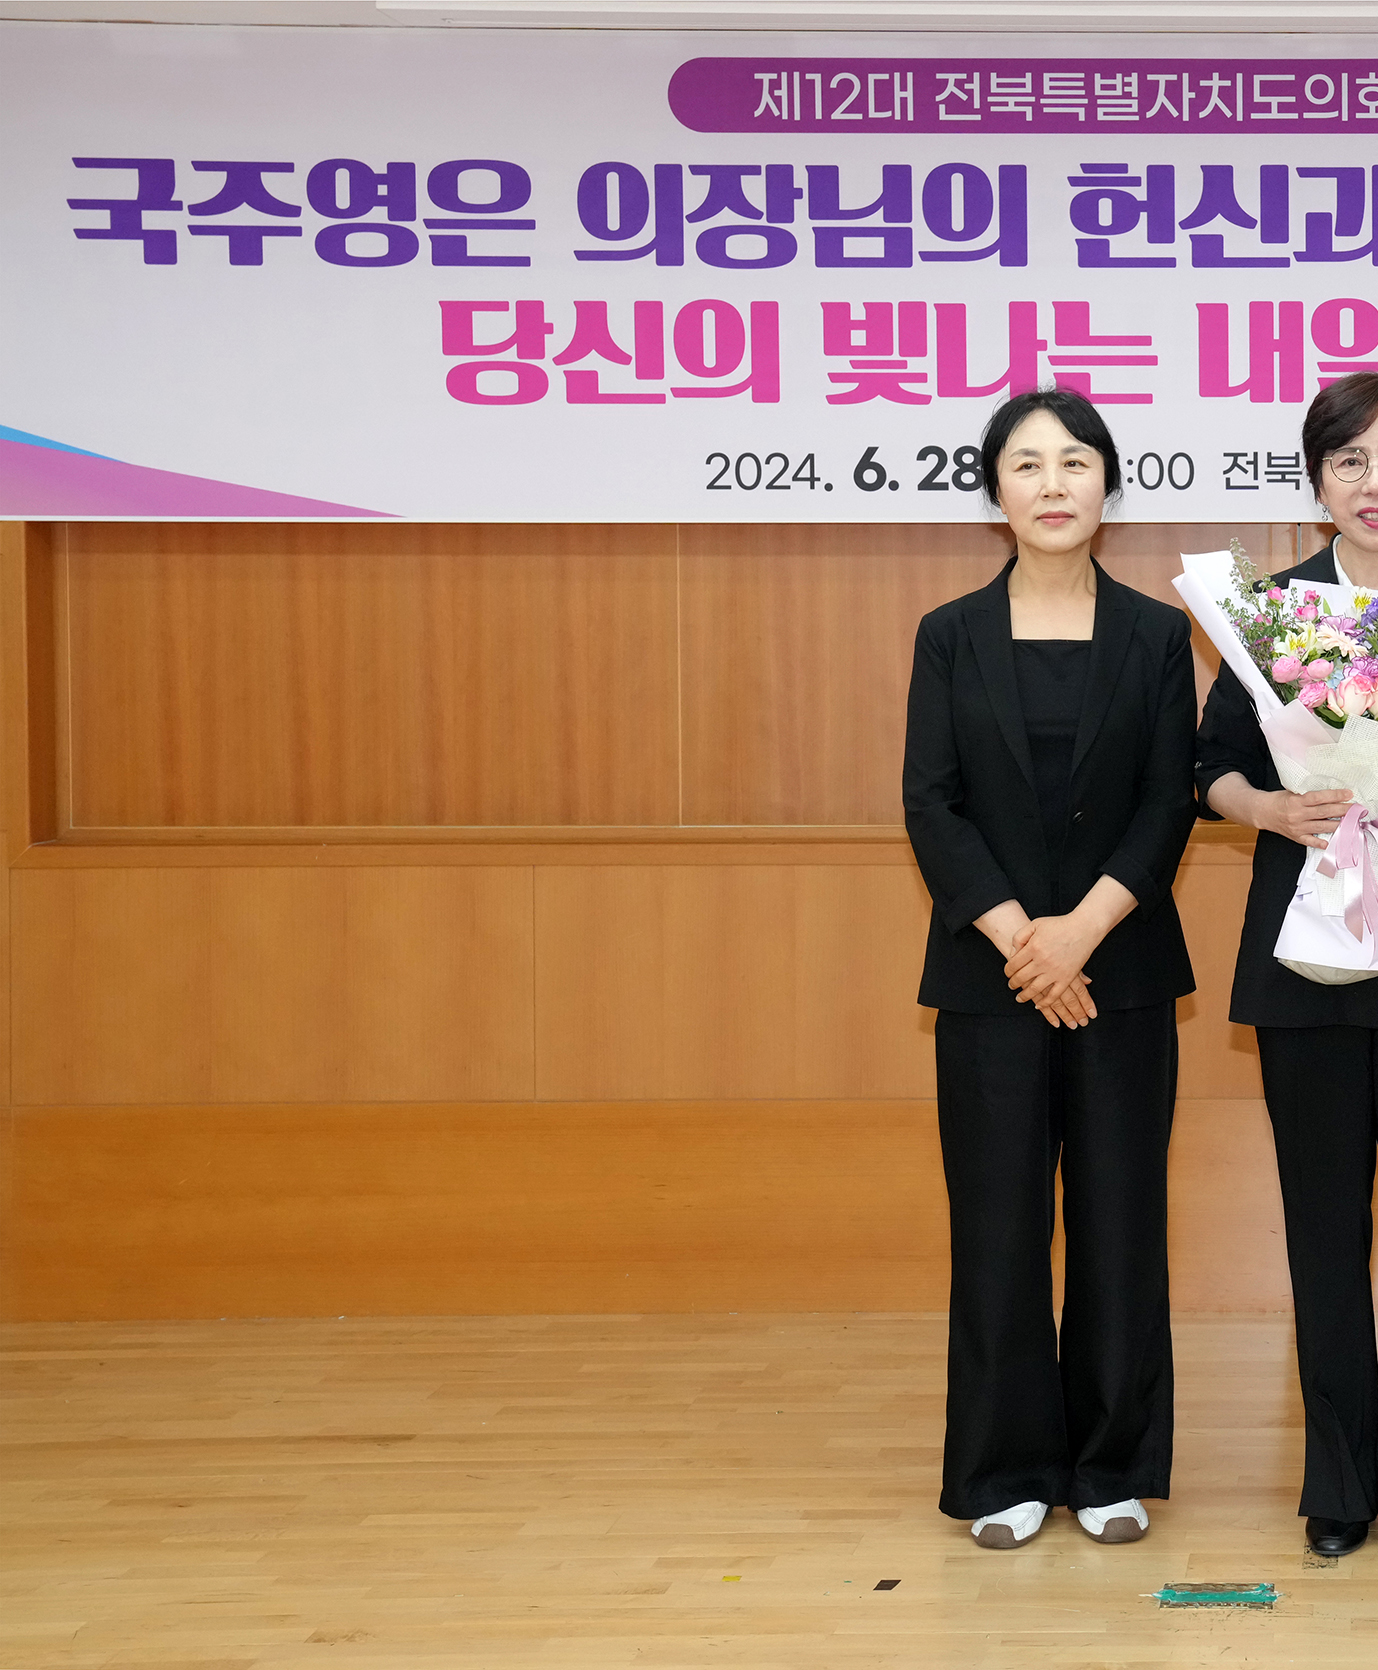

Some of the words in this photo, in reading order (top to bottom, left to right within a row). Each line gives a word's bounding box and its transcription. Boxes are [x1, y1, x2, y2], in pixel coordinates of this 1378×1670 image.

[753, 71, 914, 121] 제12대
[66, 156, 536, 268] 국주영은
[573, 160, 1029, 270] 의장님의
[438, 298, 781, 406] 당신의
[820, 300, 1159, 406] 빛나는
[705, 452, 834, 492] 2024.
[853, 446, 900, 492] 6.
[1126, 452, 1195, 491] :00
